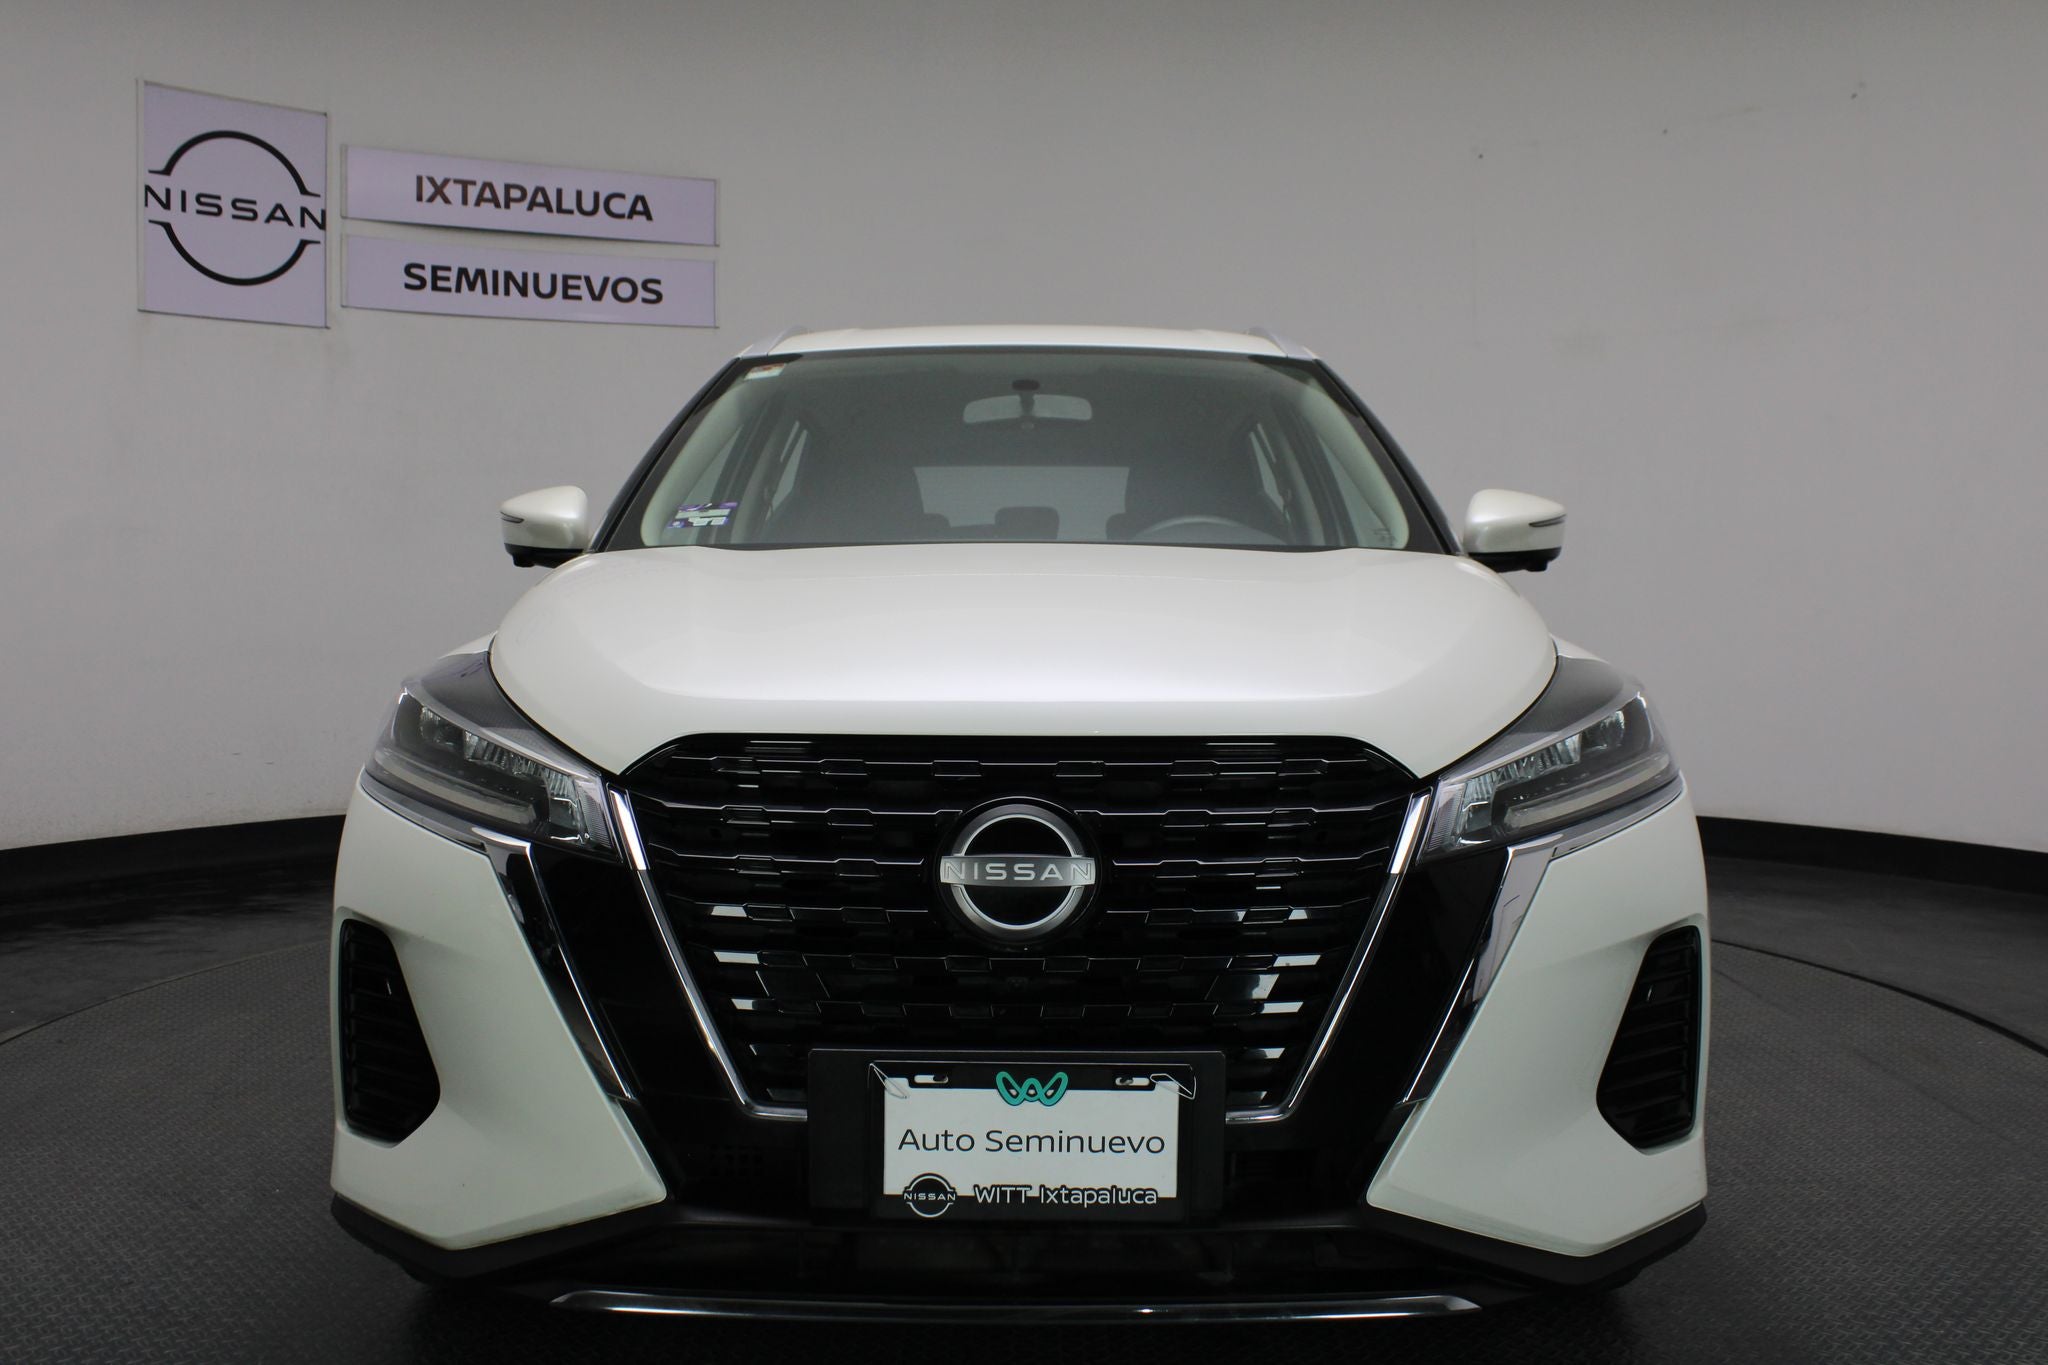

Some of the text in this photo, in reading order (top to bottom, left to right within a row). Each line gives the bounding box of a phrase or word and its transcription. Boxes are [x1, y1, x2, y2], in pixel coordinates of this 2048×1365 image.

[144, 184, 326, 231] NISSAN
[415, 174, 654, 222] IXTAPALUCA
[403, 262, 664, 305] SEMINUEVOS
[943, 861, 1092, 881] NISSAN
[898, 1128, 1165, 1154] Auto Seminuevo
[904, 1192, 956, 1201] NISSAN
[973, 1186, 1158, 1208] WITT Ixtapaluca
